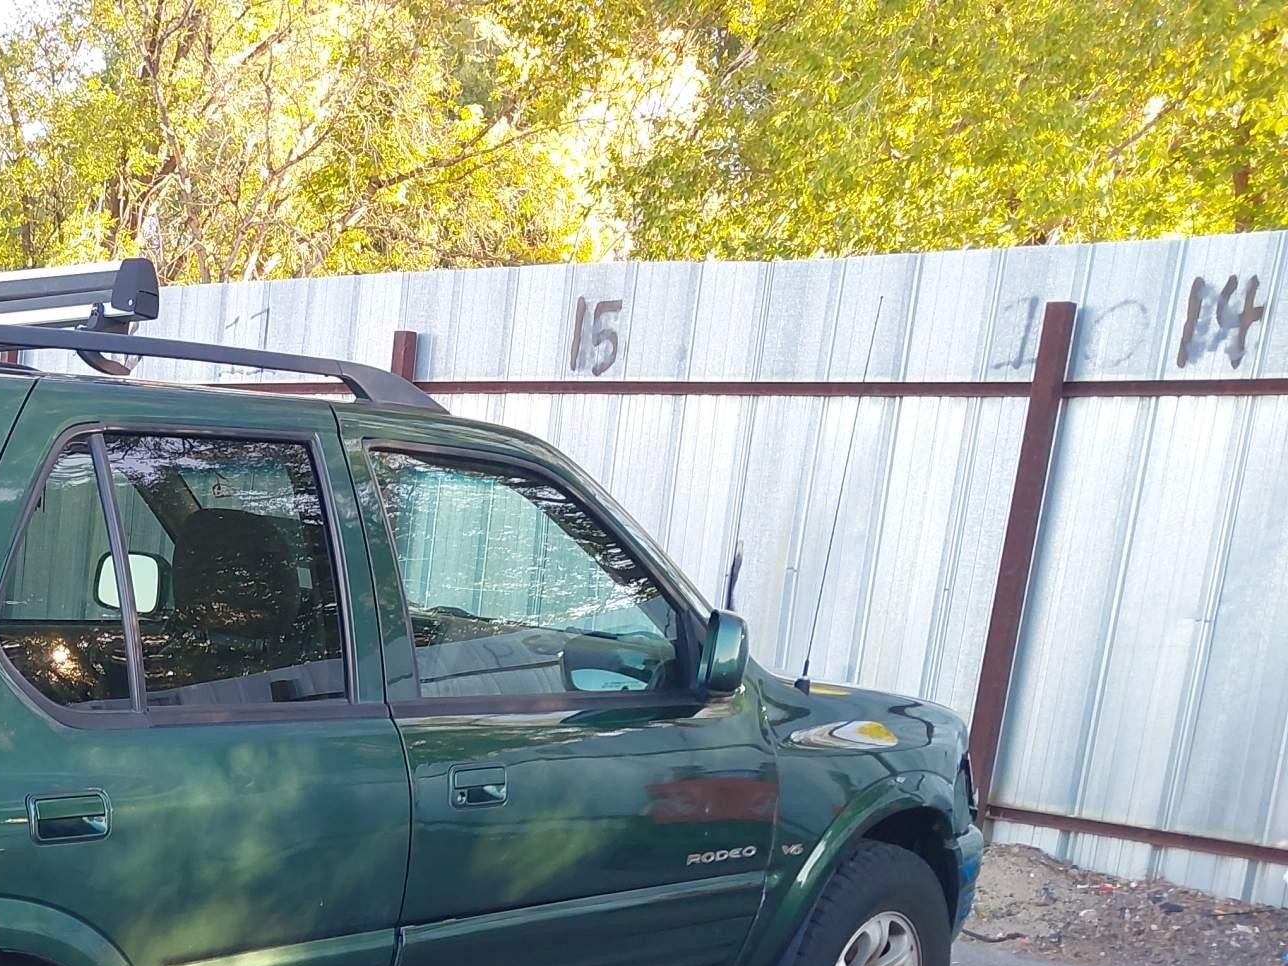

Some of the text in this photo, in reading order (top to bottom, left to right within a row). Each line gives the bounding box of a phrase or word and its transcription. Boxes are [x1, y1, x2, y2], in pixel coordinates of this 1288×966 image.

[570, 295, 623, 376] 15
[1176, 274, 1265, 370] 14
[686, 845, 758, 866] RODEO
[781, 843, 804, 855] V6
